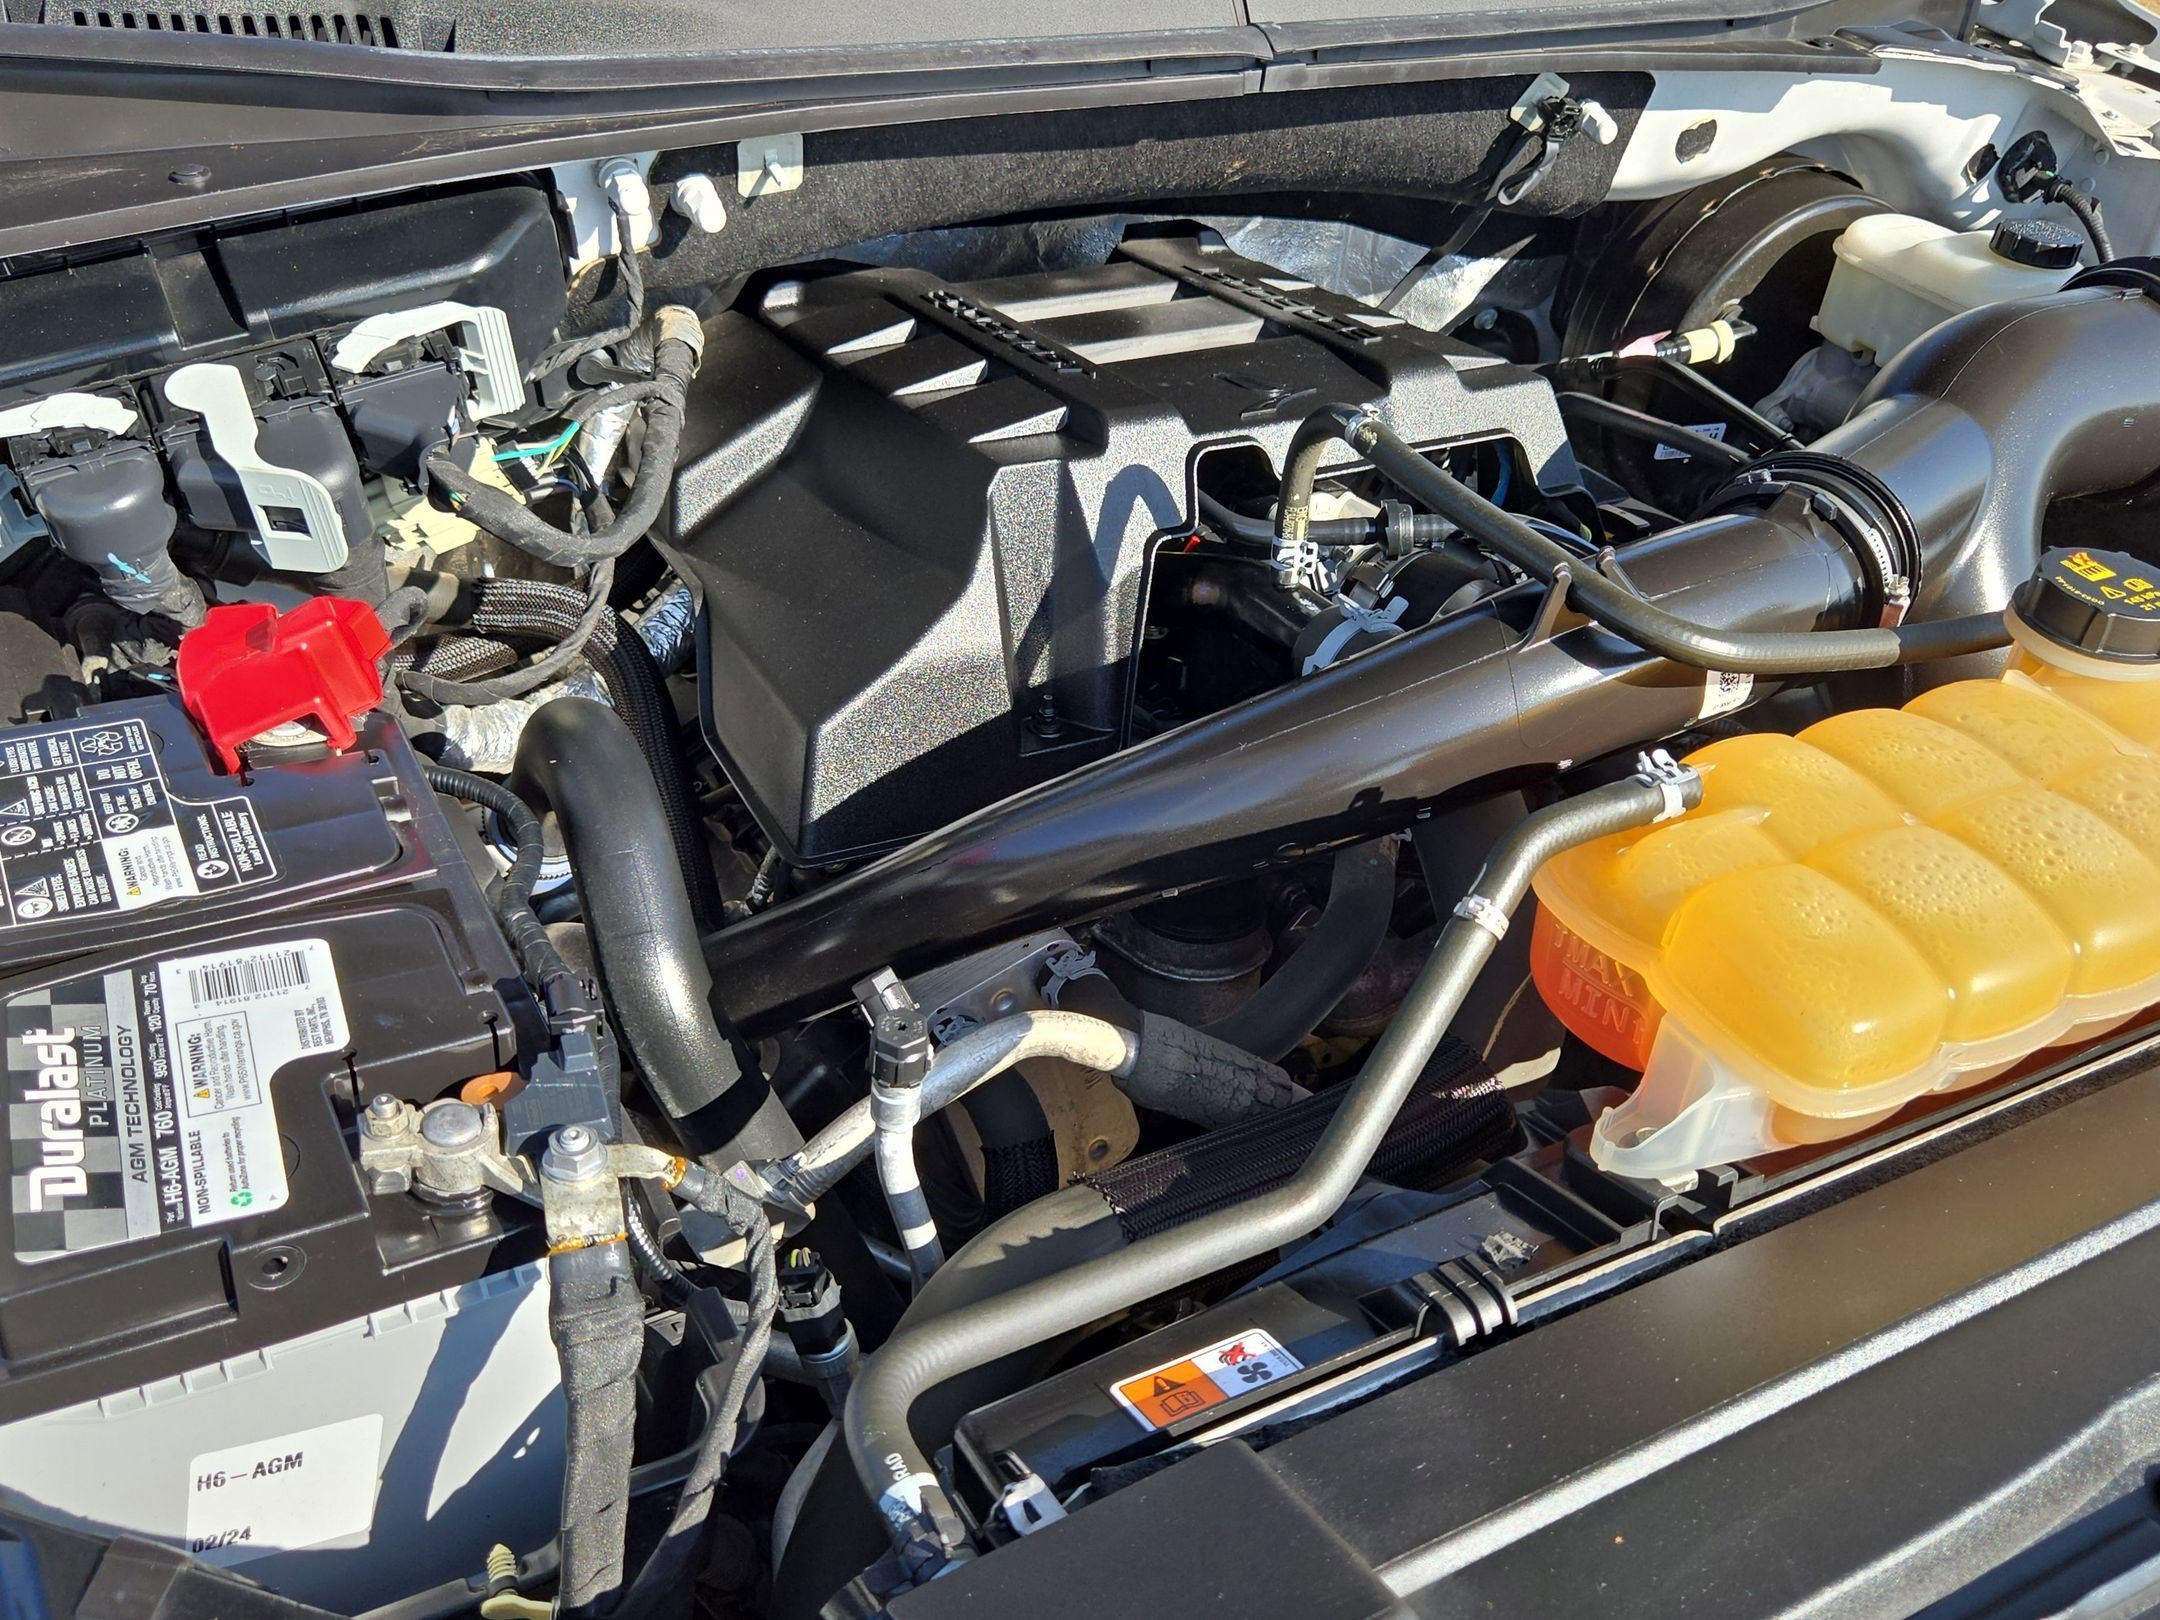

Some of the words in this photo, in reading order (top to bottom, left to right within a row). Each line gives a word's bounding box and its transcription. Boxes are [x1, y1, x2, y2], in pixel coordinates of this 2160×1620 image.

[62, 753, 74, 765] HELP
[96, 769, 111, 780] DO
[112, 765, 128, 780] NOT
[44, 786, 56, 802] CAUSE
[100, 792, 111, 803] OUT
[116, 795, 126, 805] THE
[48, 802, 59, 812] CAN
[103, 803, 114, 814] KEEP
[237, 812, 256, 836] Battery
[197, 814, 220, 859] INSTRUCTIONS.
[221, 810, 253, 872] NON-SPILLABLE
[245, 835, 259, 849] Acid
[195, 844, 208, 860] READ
[248, 848, 264, 866] Lead
[118, 848, 138, 888] WARNING:
[68, 877, 86, 909] EXPLOSIVE
[83, 877, 96, 894] CAUSE
[88, 894, 99, 906] CAN
[144, 984, 157, 997] 70
[1559, 966, 1632, 1033] MIN
[148, 1014, 162, 1032] 120
[296, 1016, 311, 1050] DISTRIBUTED
[313, 1034, 323, 1047] BEST
[188, 1032, 208, 1089] WARNING:
[205, 1038, 218, 1076] Reproductive
[220, 1050, 230, 1063] after
[82, 1026, 110, 1128] PLATINUM
[153, 1058, 168, 1078] 950
[222, 1064, 232, 1082] hands
[117, 1025, 144, 1138] TECHNOLOGY
[211, 1076, 220, 1087] and
[212, 1087, 224, 1110] Cancer
[225, 1083, 235, 1100] Wash
[22, 1027, 88, 1212] Duralast
[154, 1110, 174, 1140] 760
[232, 1116, 243, 1139] recycling
[224, 1140, 234, 1163] batteries
[236, 1140, 245, 1157] proper
[130, 1142, 148, 1184] AGM
[188, 1130, 212, 1214] NON-SPILLABLE
[227, 1164, 235, 1177] used
[158, 1146, 184, 1206] H6-AGM
[229, 1177, 238, 1192] Return
[239, 1165, 250, 1190] AutoZone
[884, 1452, 911, 1481] RAD
[192, 1526, 252, 1554] 02/24
